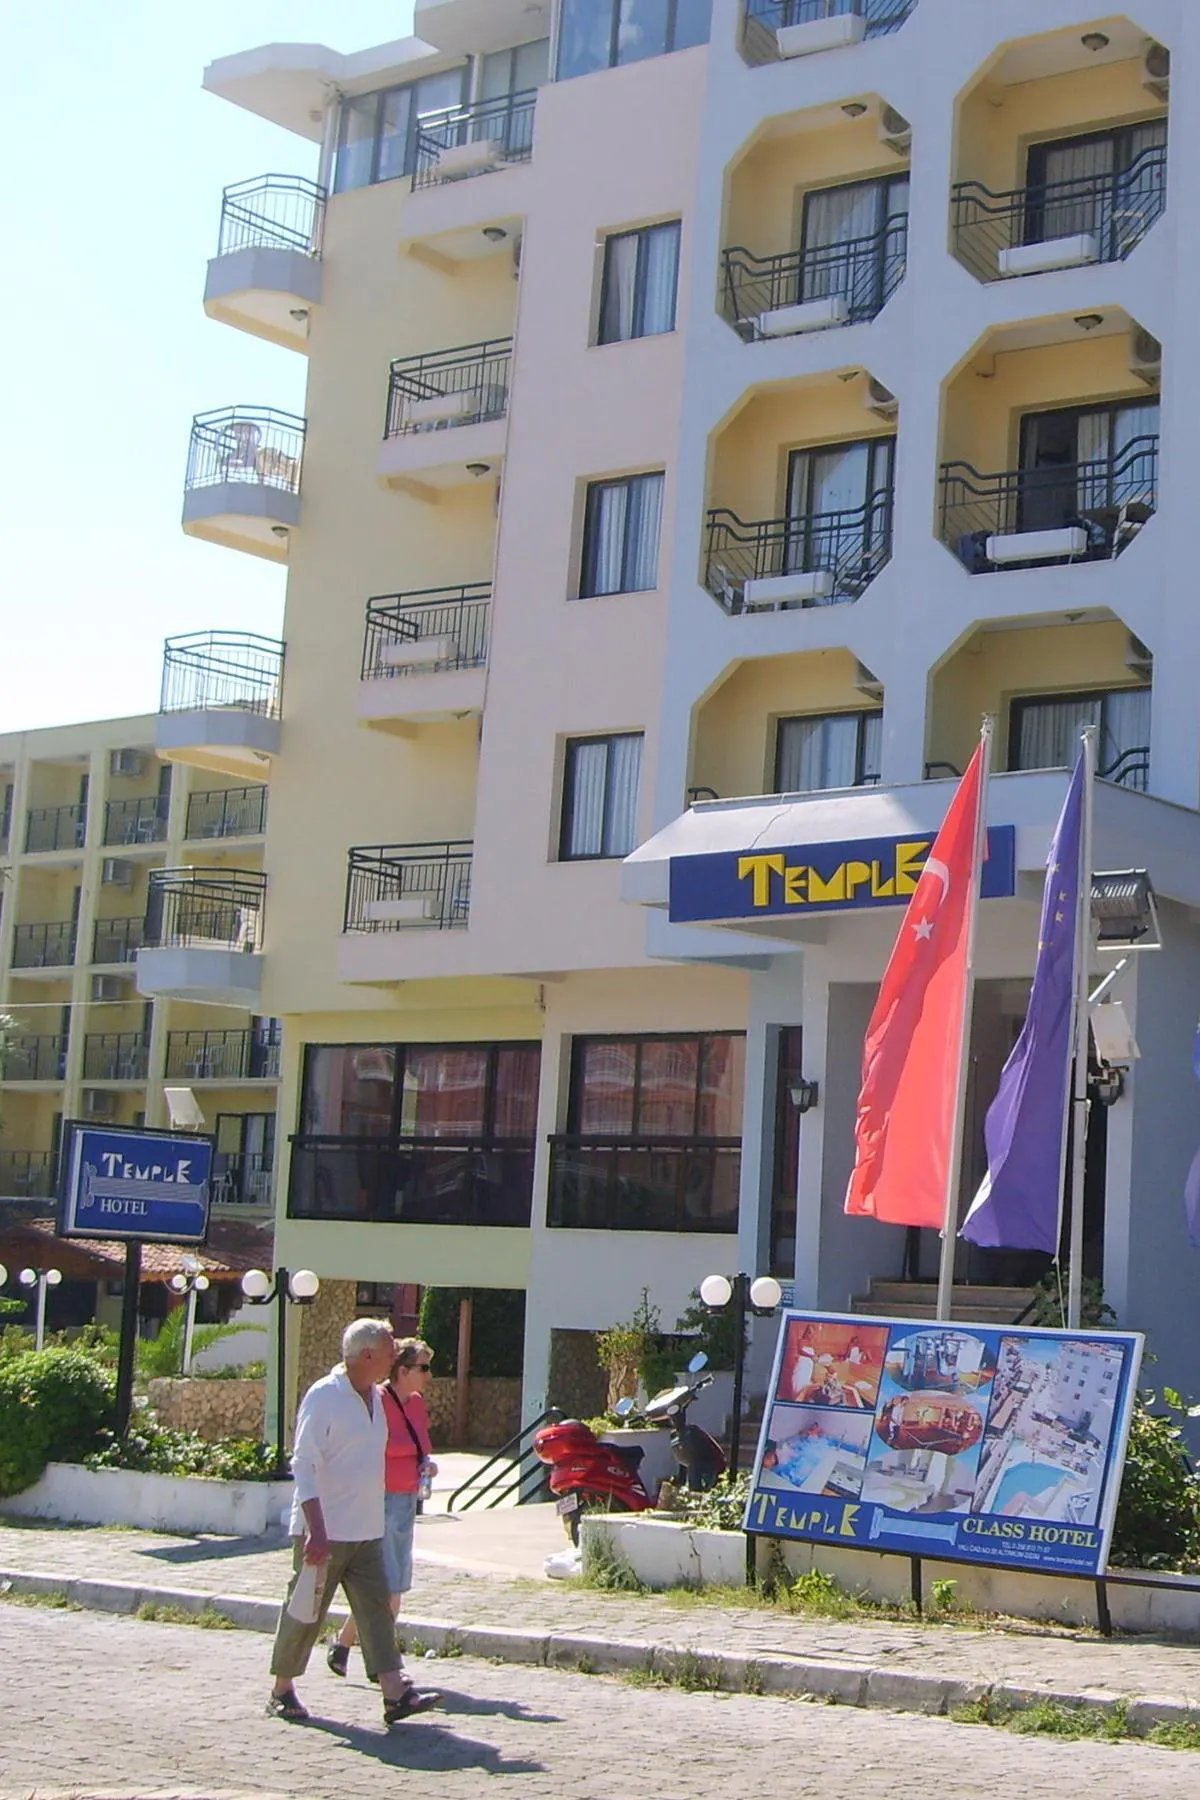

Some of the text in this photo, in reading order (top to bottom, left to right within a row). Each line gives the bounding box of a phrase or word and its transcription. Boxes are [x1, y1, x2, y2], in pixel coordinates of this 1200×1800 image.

[738, 842, 931, 907] TEMPLE
[102, 1152, 192, 1184] TEMPLE
[100, 1198, 148, 1216] HOTEL
[753, 1492, 861, 1537] TEMPLE
[962, 1518, 1025, 1539] CLASS
[1029, 1525, 1099, 1549] HOTEL
